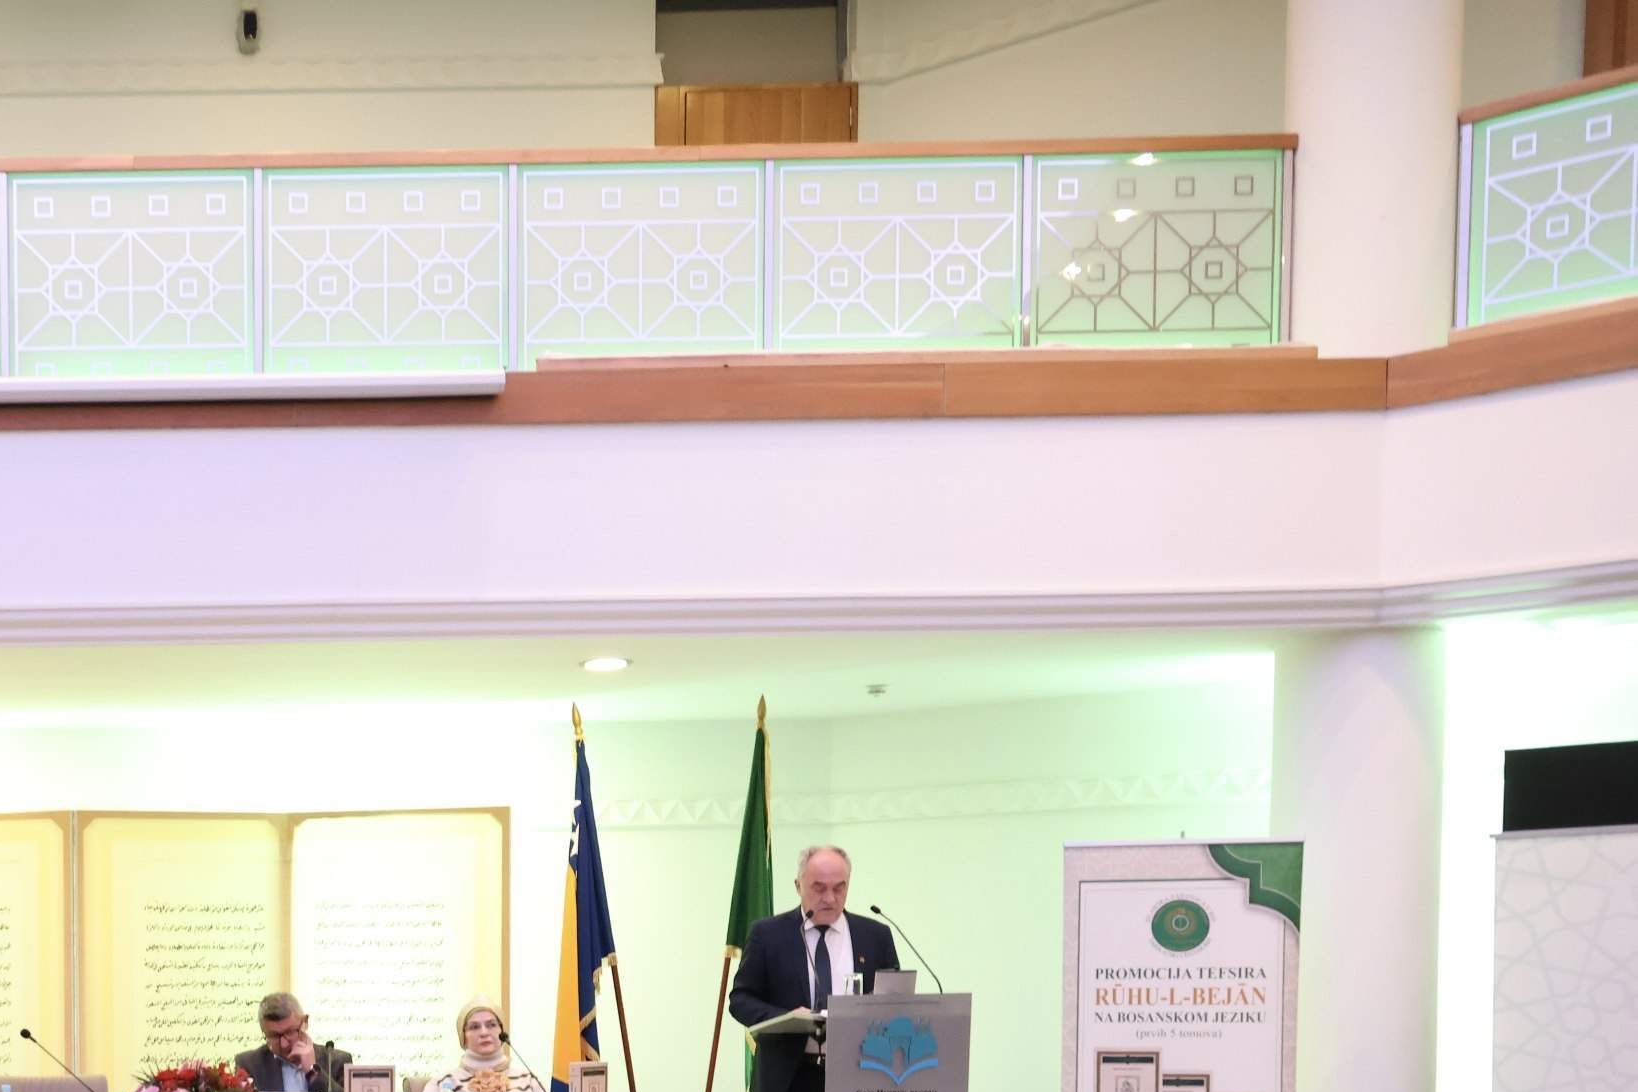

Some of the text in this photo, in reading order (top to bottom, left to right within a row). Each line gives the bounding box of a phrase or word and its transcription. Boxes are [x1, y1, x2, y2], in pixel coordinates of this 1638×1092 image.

[1095, 966, 1267, 981] PROMOCIJA TEFSIRA
[1095, 983, 1266, 1007] RŪHU-L-BEJĀN
[1093, 1010, 1267, 1024] NA BOSANSKOM JEZIKU
